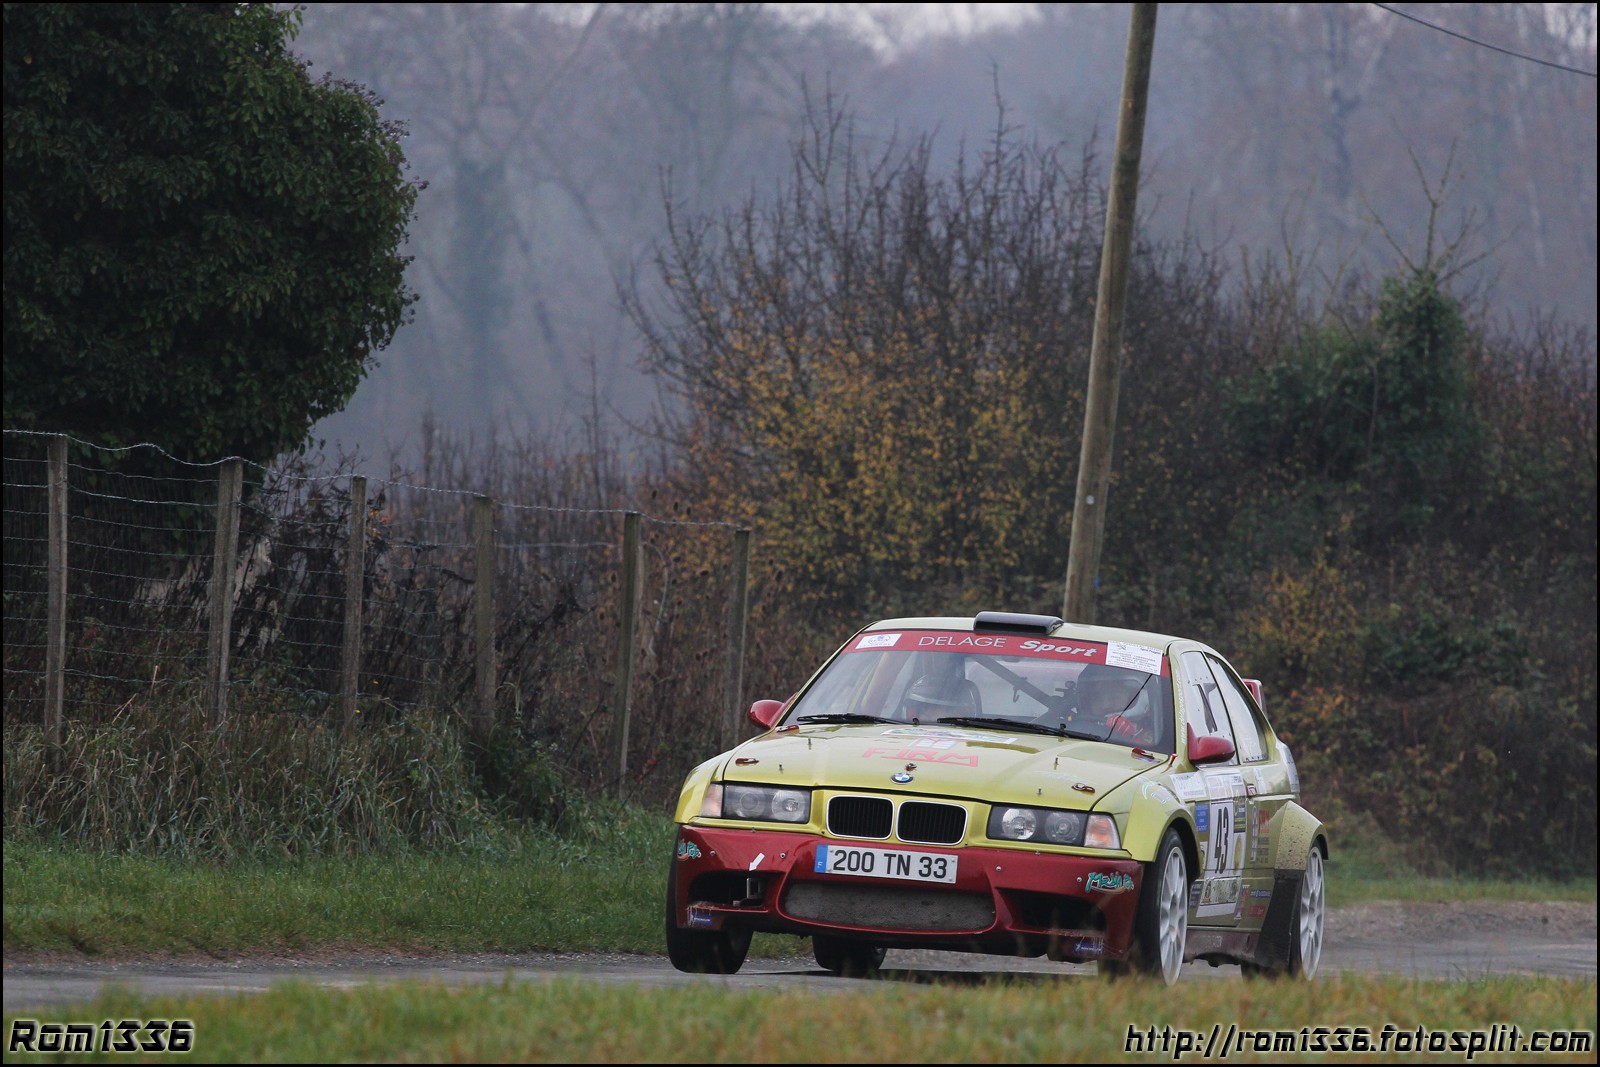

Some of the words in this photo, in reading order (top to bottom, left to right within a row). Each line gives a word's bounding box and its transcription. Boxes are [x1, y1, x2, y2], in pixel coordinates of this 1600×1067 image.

[918, 636, 1007, 648] DELAGE
[1020, 640, 1097, 657] Sport
[1214, 806, 1230, 875] 43
[833, 849, 875, 873] 200
[884, 853, 911, 876] TN
[918, 856, 948, 879] 33
